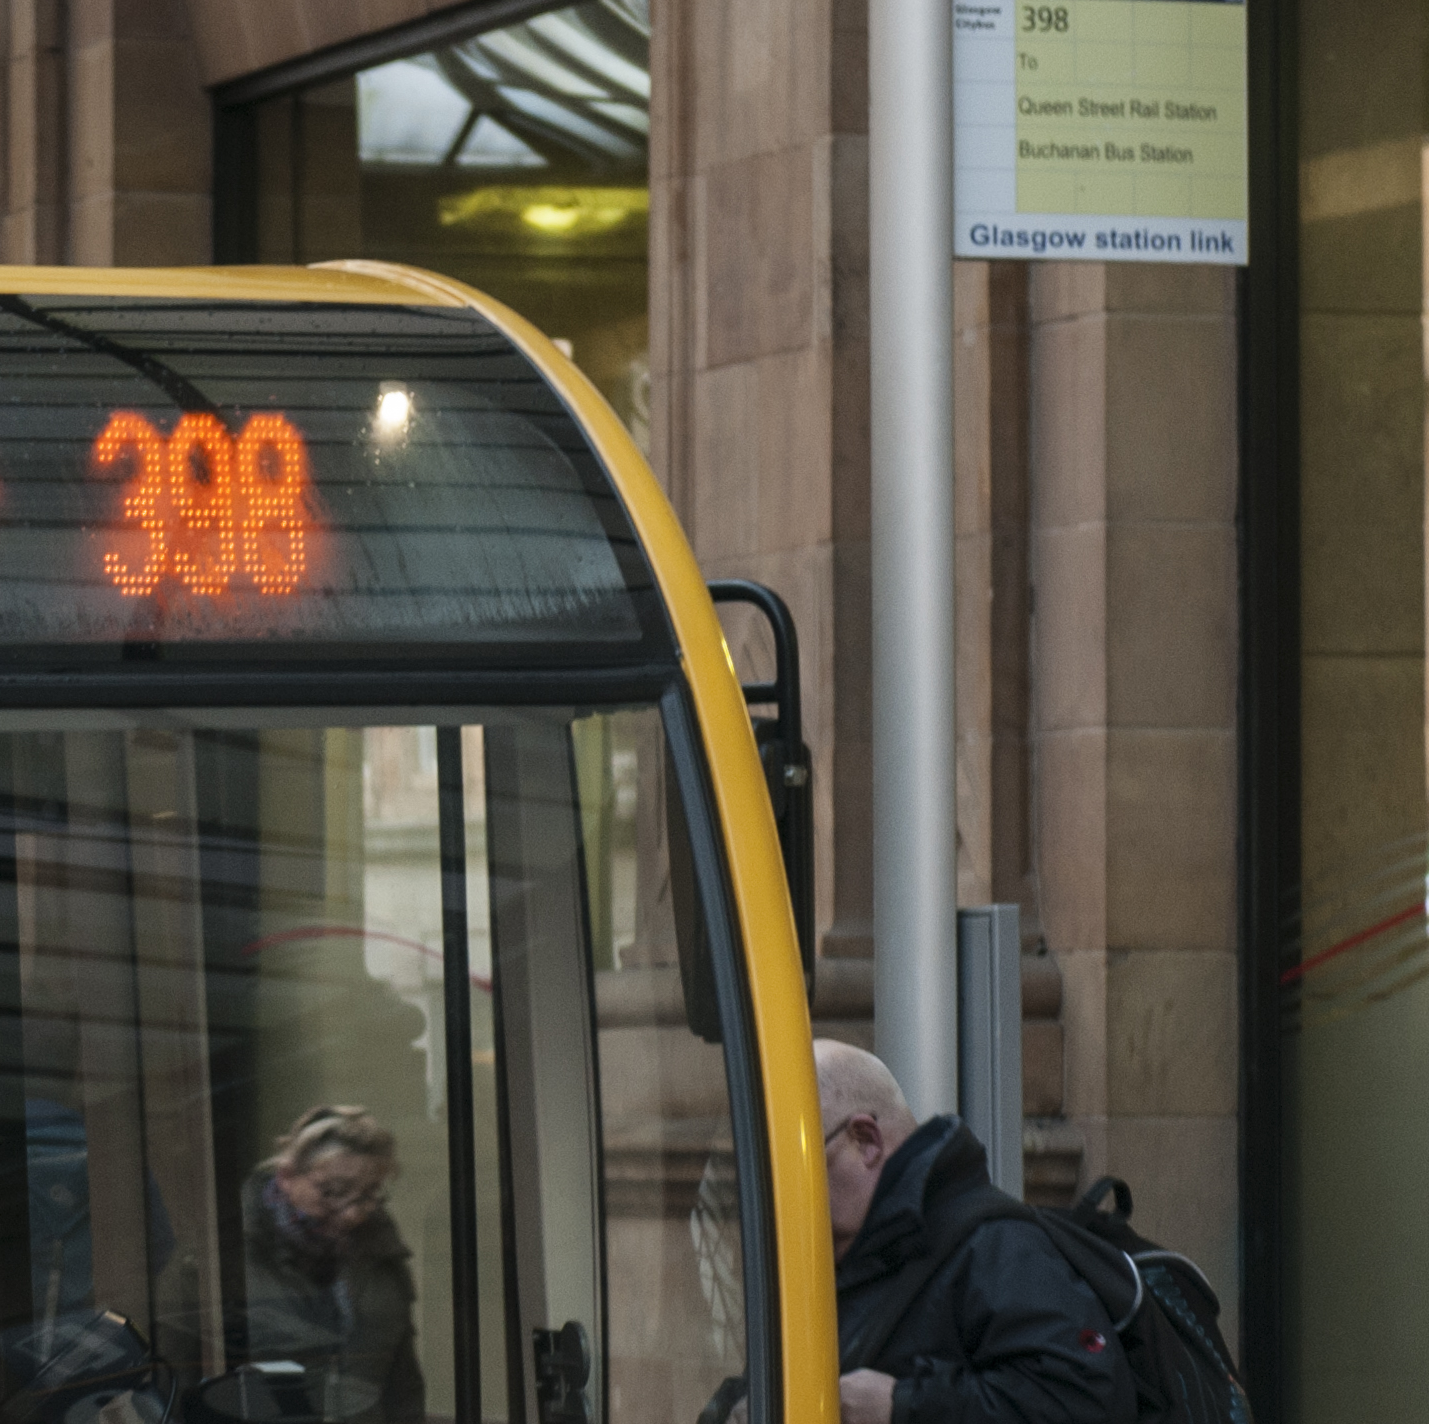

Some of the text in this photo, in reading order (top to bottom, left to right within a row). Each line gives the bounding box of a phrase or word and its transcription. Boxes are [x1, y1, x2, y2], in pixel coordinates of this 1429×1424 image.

[1022, 6, 1069, 32] 398
[1019, 52, 1038, 70] To
[1018, 96, 1218, 121] Queen Street Rail Station
[1018, 139, 1193, 163] Buchanan Bus Station
[970, 224, 1234, 253] Glasgow station link
[93, 413, 306, 596] 398
